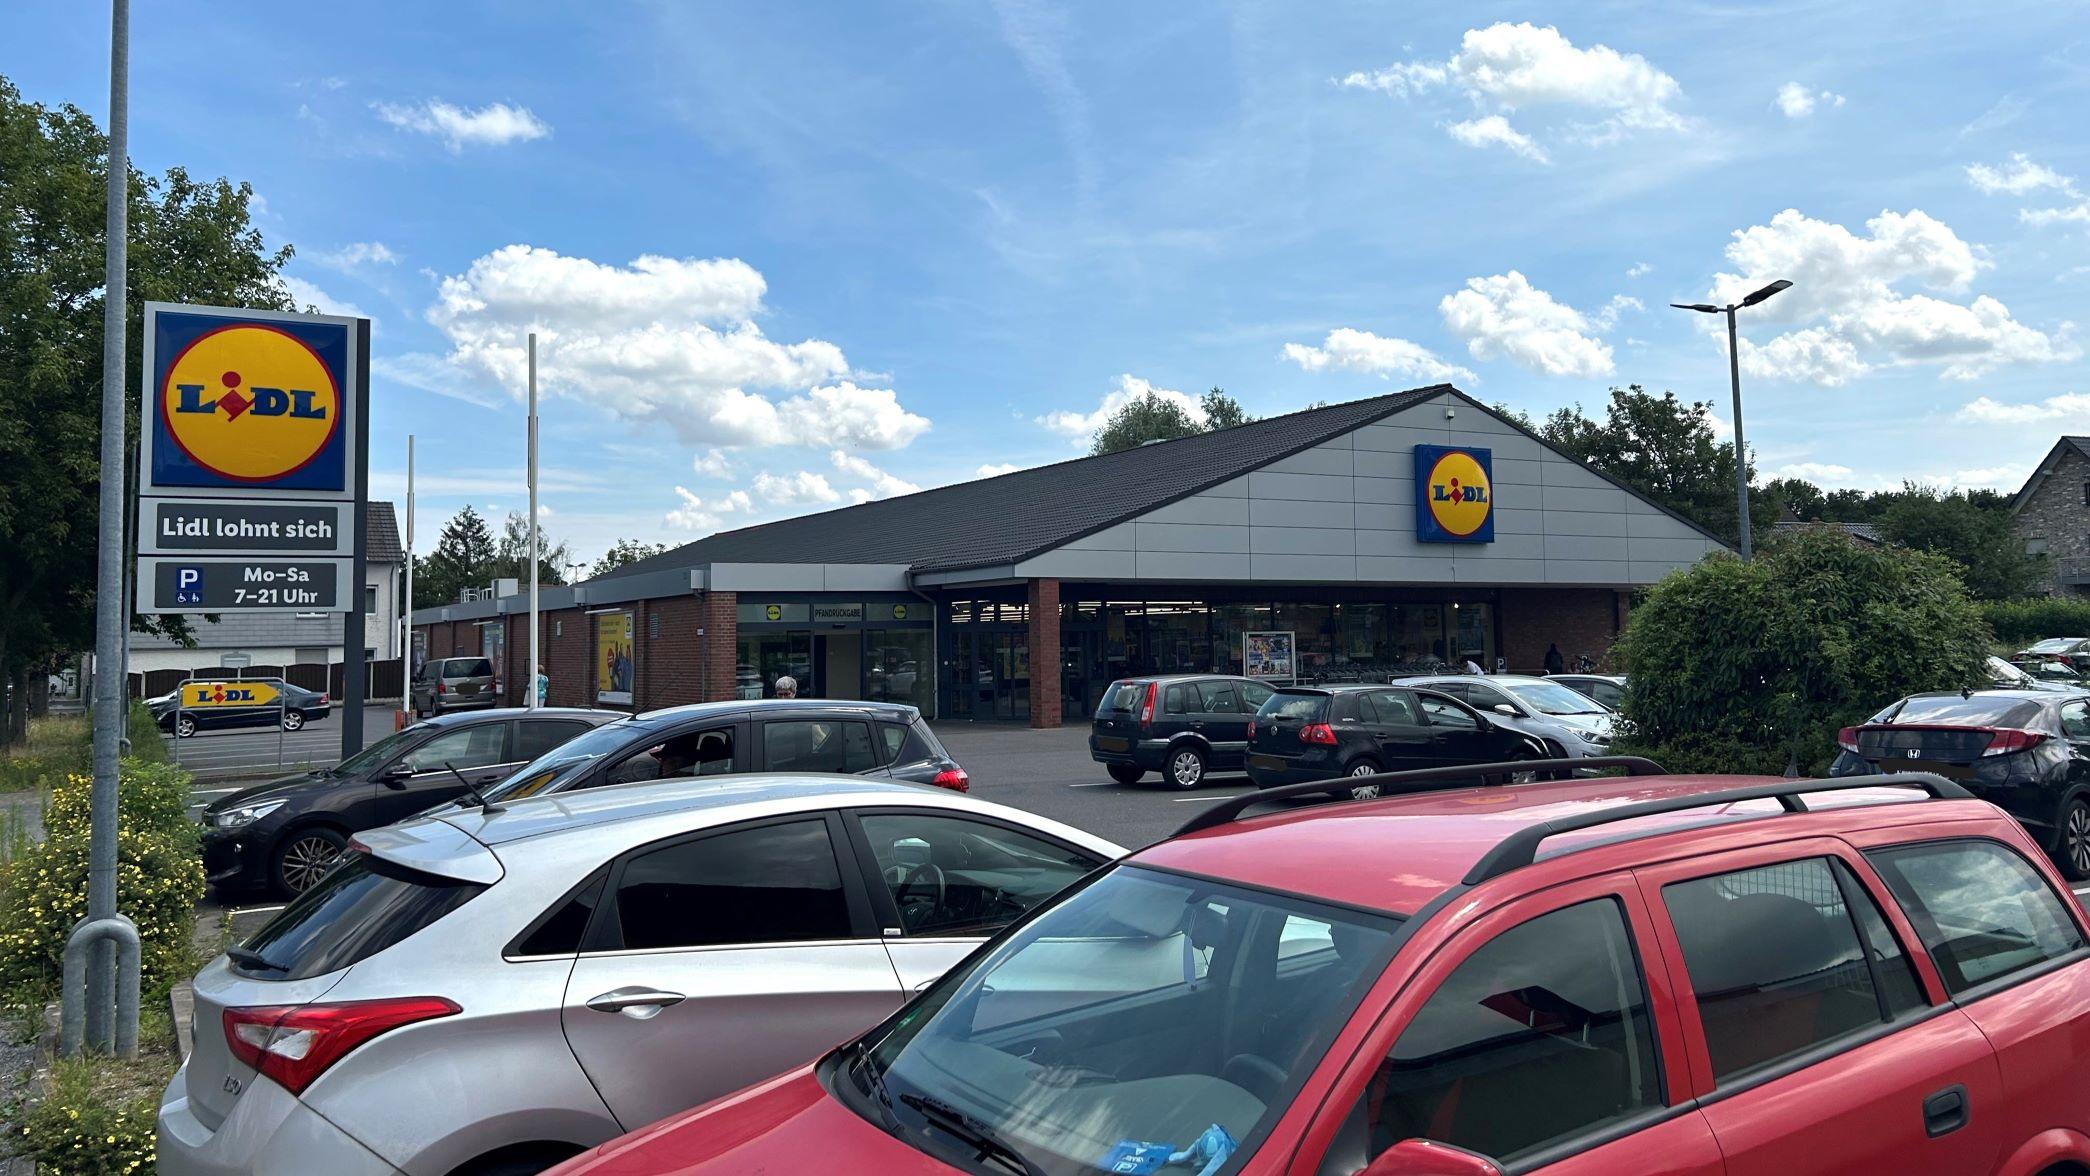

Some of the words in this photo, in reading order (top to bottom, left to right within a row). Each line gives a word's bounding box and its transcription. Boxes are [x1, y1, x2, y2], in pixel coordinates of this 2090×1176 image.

[176, 371, 326, 423] LIDL
[1433, 478, 1488, 506] LIDL
[163, 516, 209, 536] Lidl
[216, 518, 280, 537] lohnt
[285, 519, 332, 538] sich
[180, 569, 198, 588] P
[244, 567, 310, 582] Mo–Sa
[234, 589, 278, 604] 7–21
[283, 588, 318, 603] Uhr
[815, 607, 861, 617] PFANDRÜCKGABE
[1497, 658, 1505, 669] P
[198, 684, 255, 704] LIDL
